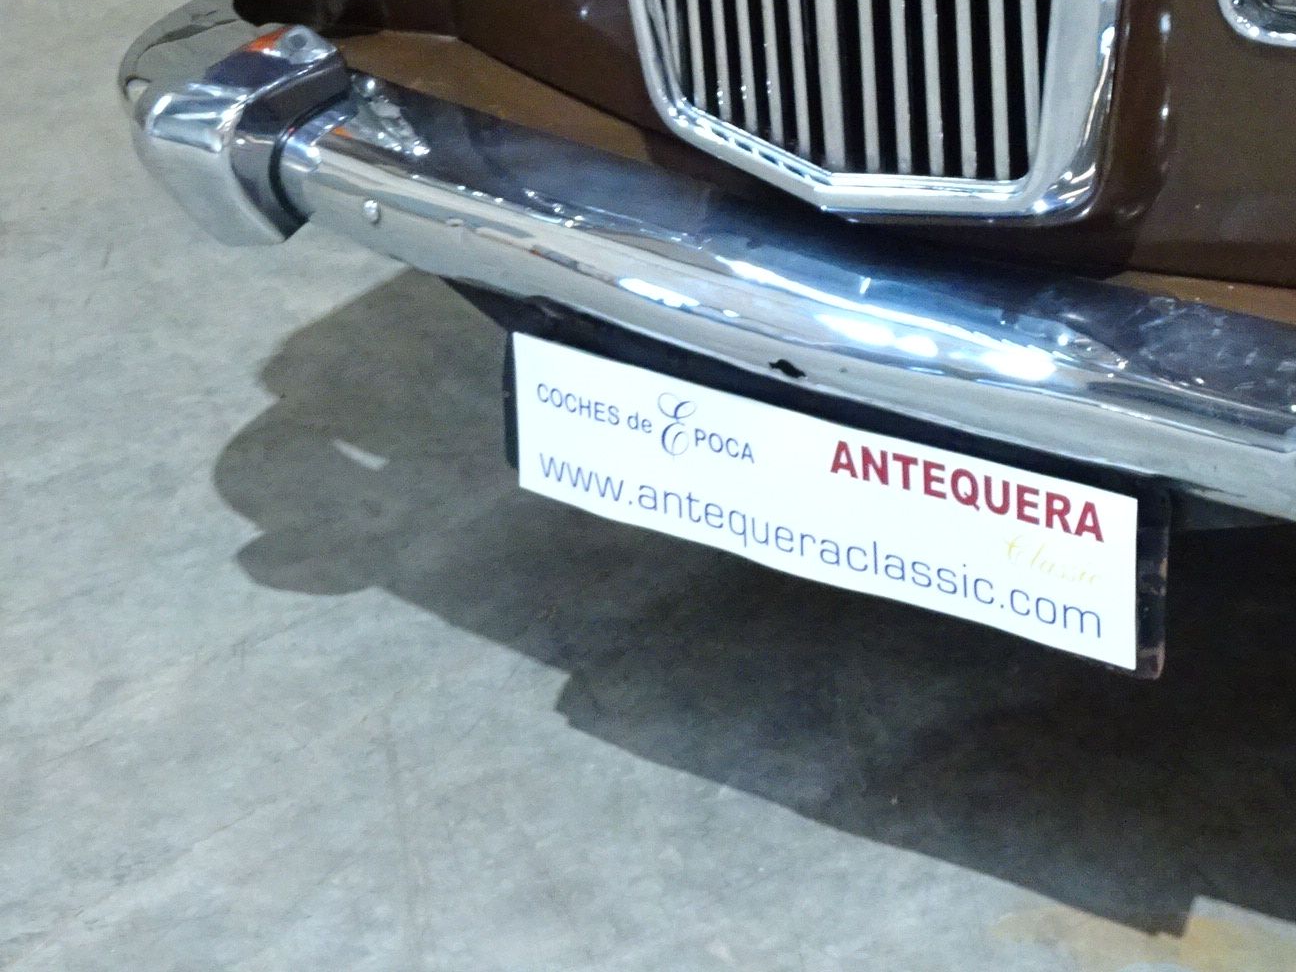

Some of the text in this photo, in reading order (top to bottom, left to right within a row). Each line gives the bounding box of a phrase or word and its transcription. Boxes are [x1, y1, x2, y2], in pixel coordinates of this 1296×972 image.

[537, 383, 620, 425] COCHES
[627, 412, 652, 434] de
[830, 440, 1104, 543] ANTEQUERA
[539, 452, 1101, 638] www.antequeraclassic.com
